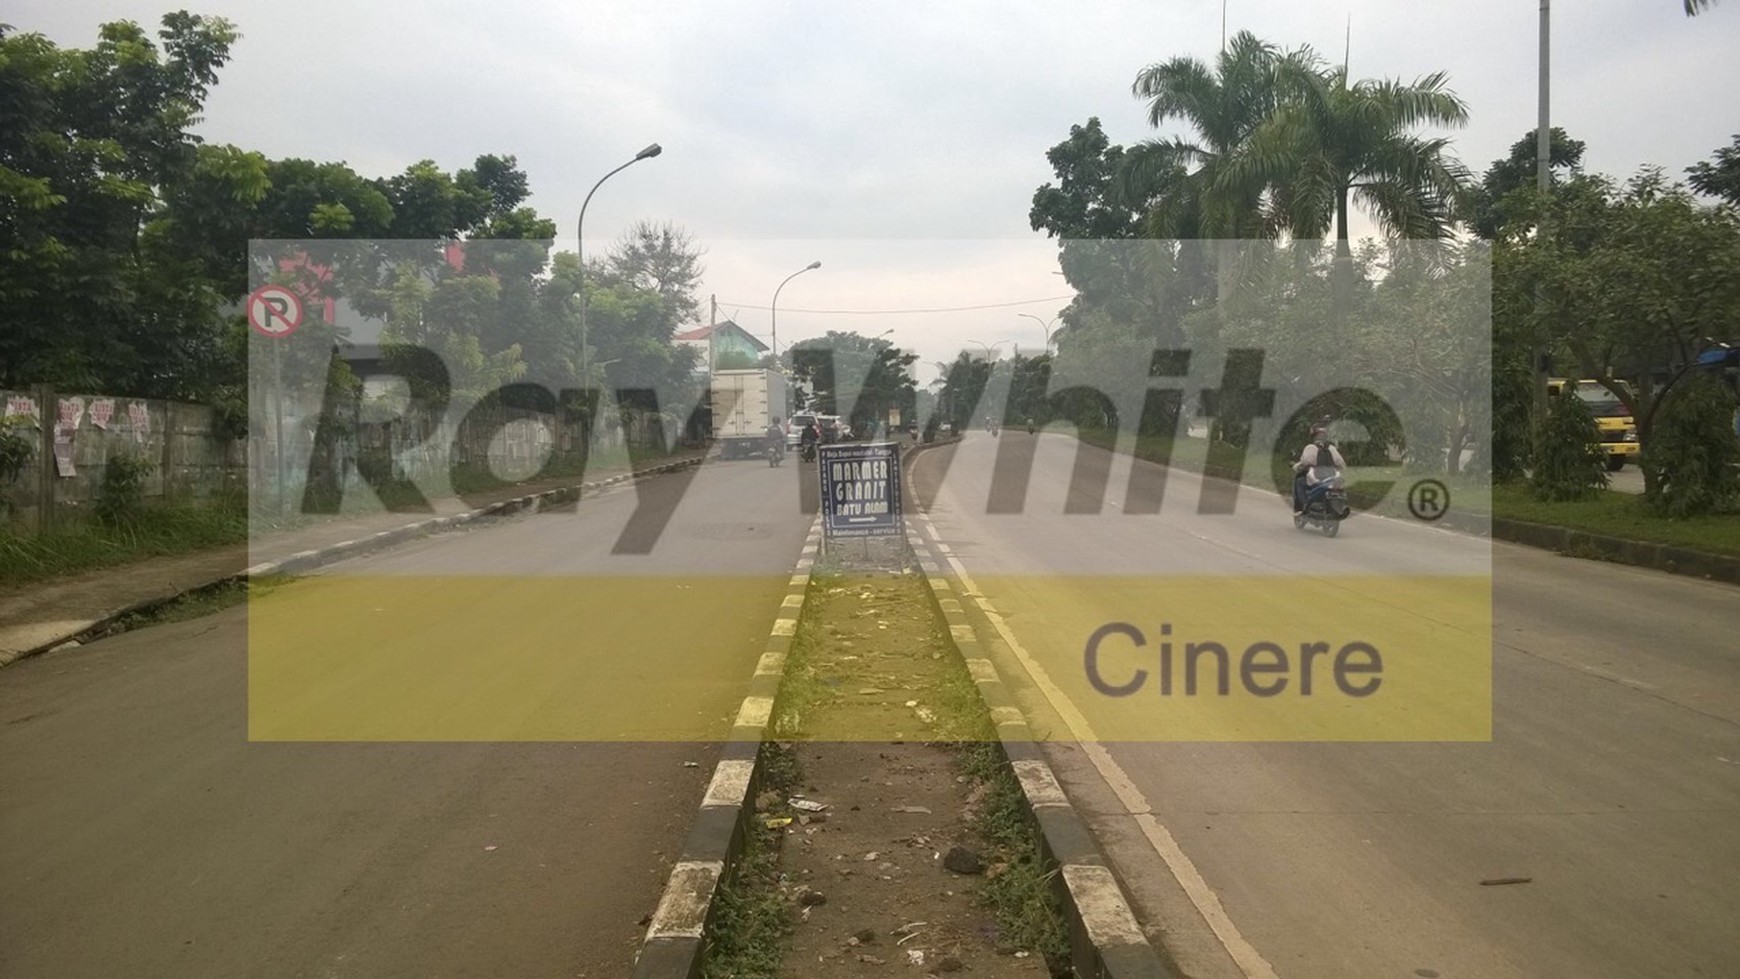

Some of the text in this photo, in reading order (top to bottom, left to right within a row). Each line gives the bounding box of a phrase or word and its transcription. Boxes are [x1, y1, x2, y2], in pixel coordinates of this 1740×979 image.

[264, 297, 288, 327] P
[833, 461, 888, 481] MARMER
[835, 481, 887, 501] GRANIT
[837, 501, 888, 516] BATU ALAM
